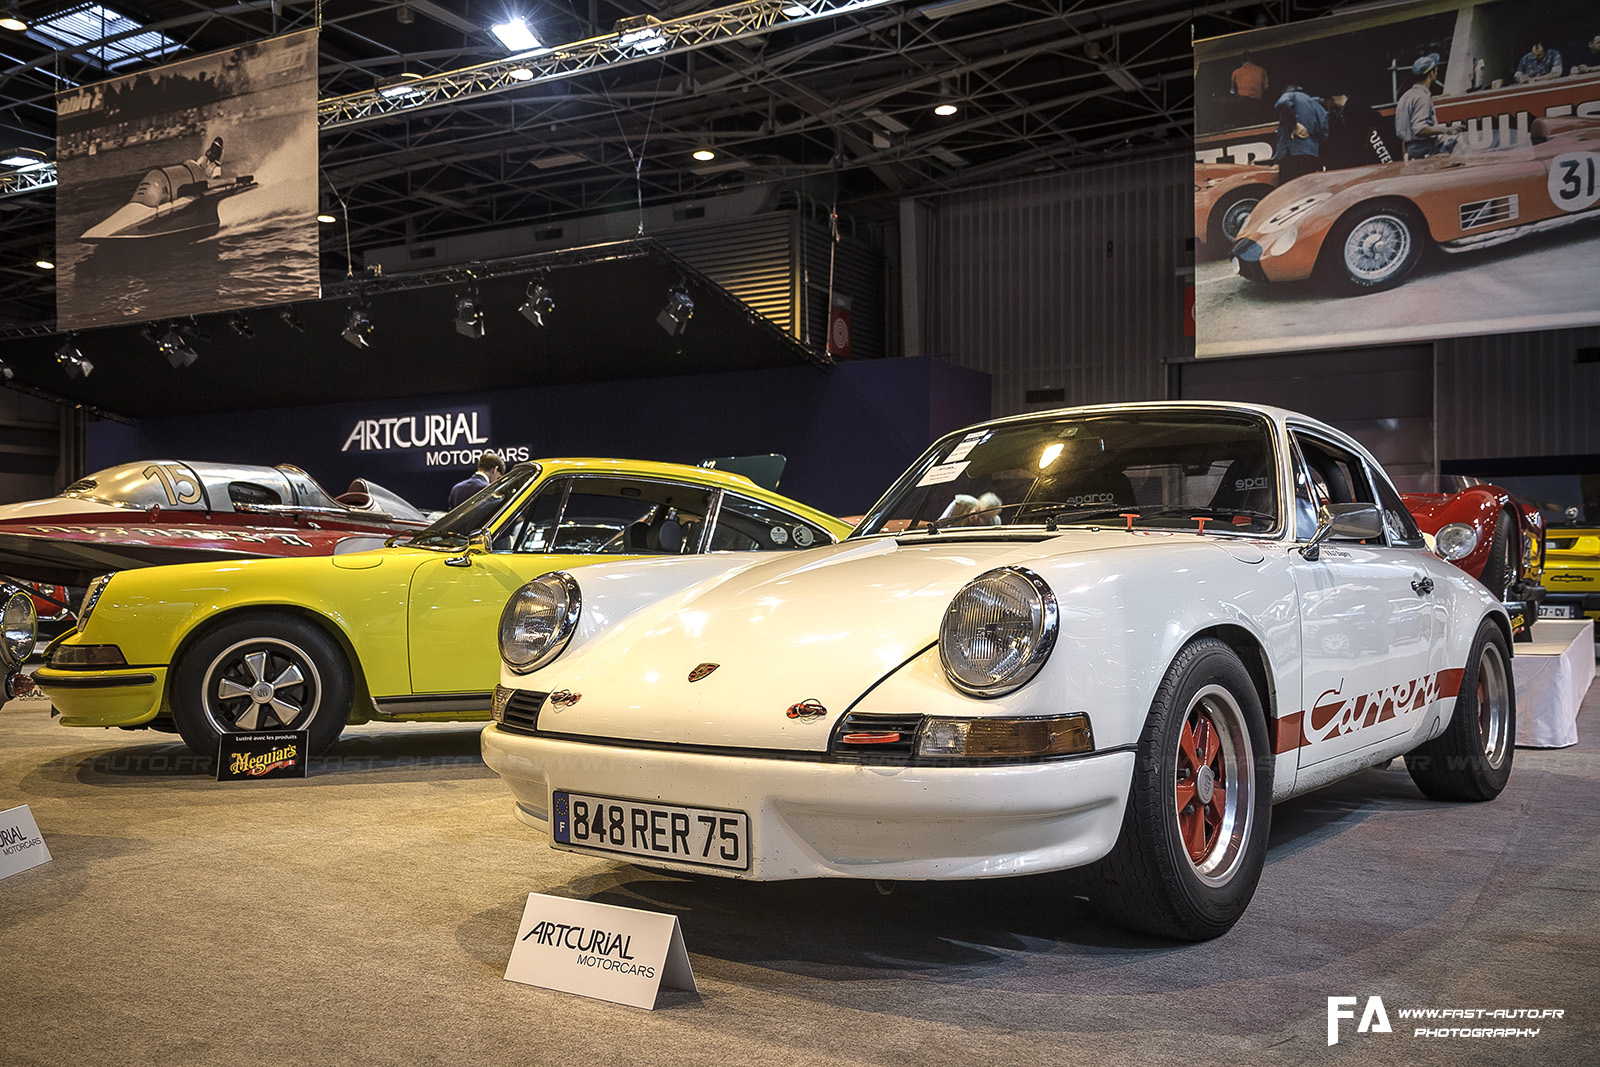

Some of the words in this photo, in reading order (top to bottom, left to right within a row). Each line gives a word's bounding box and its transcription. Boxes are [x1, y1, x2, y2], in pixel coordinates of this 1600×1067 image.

[1559, 157, 1596, 200] 31
[1304, 677, 1439, 742] Carrera
[230, 744, 297, 775] Meguiar's
[559, 821, 566, 833] F
[573, 800, 625, 846] 848
[631, 808, 690, 855] RER
[698, 815, 739, 861] 75
[3, 837, 42, 857] MOTORCARS
[576, 954, 656, 979] MOTORCARS
